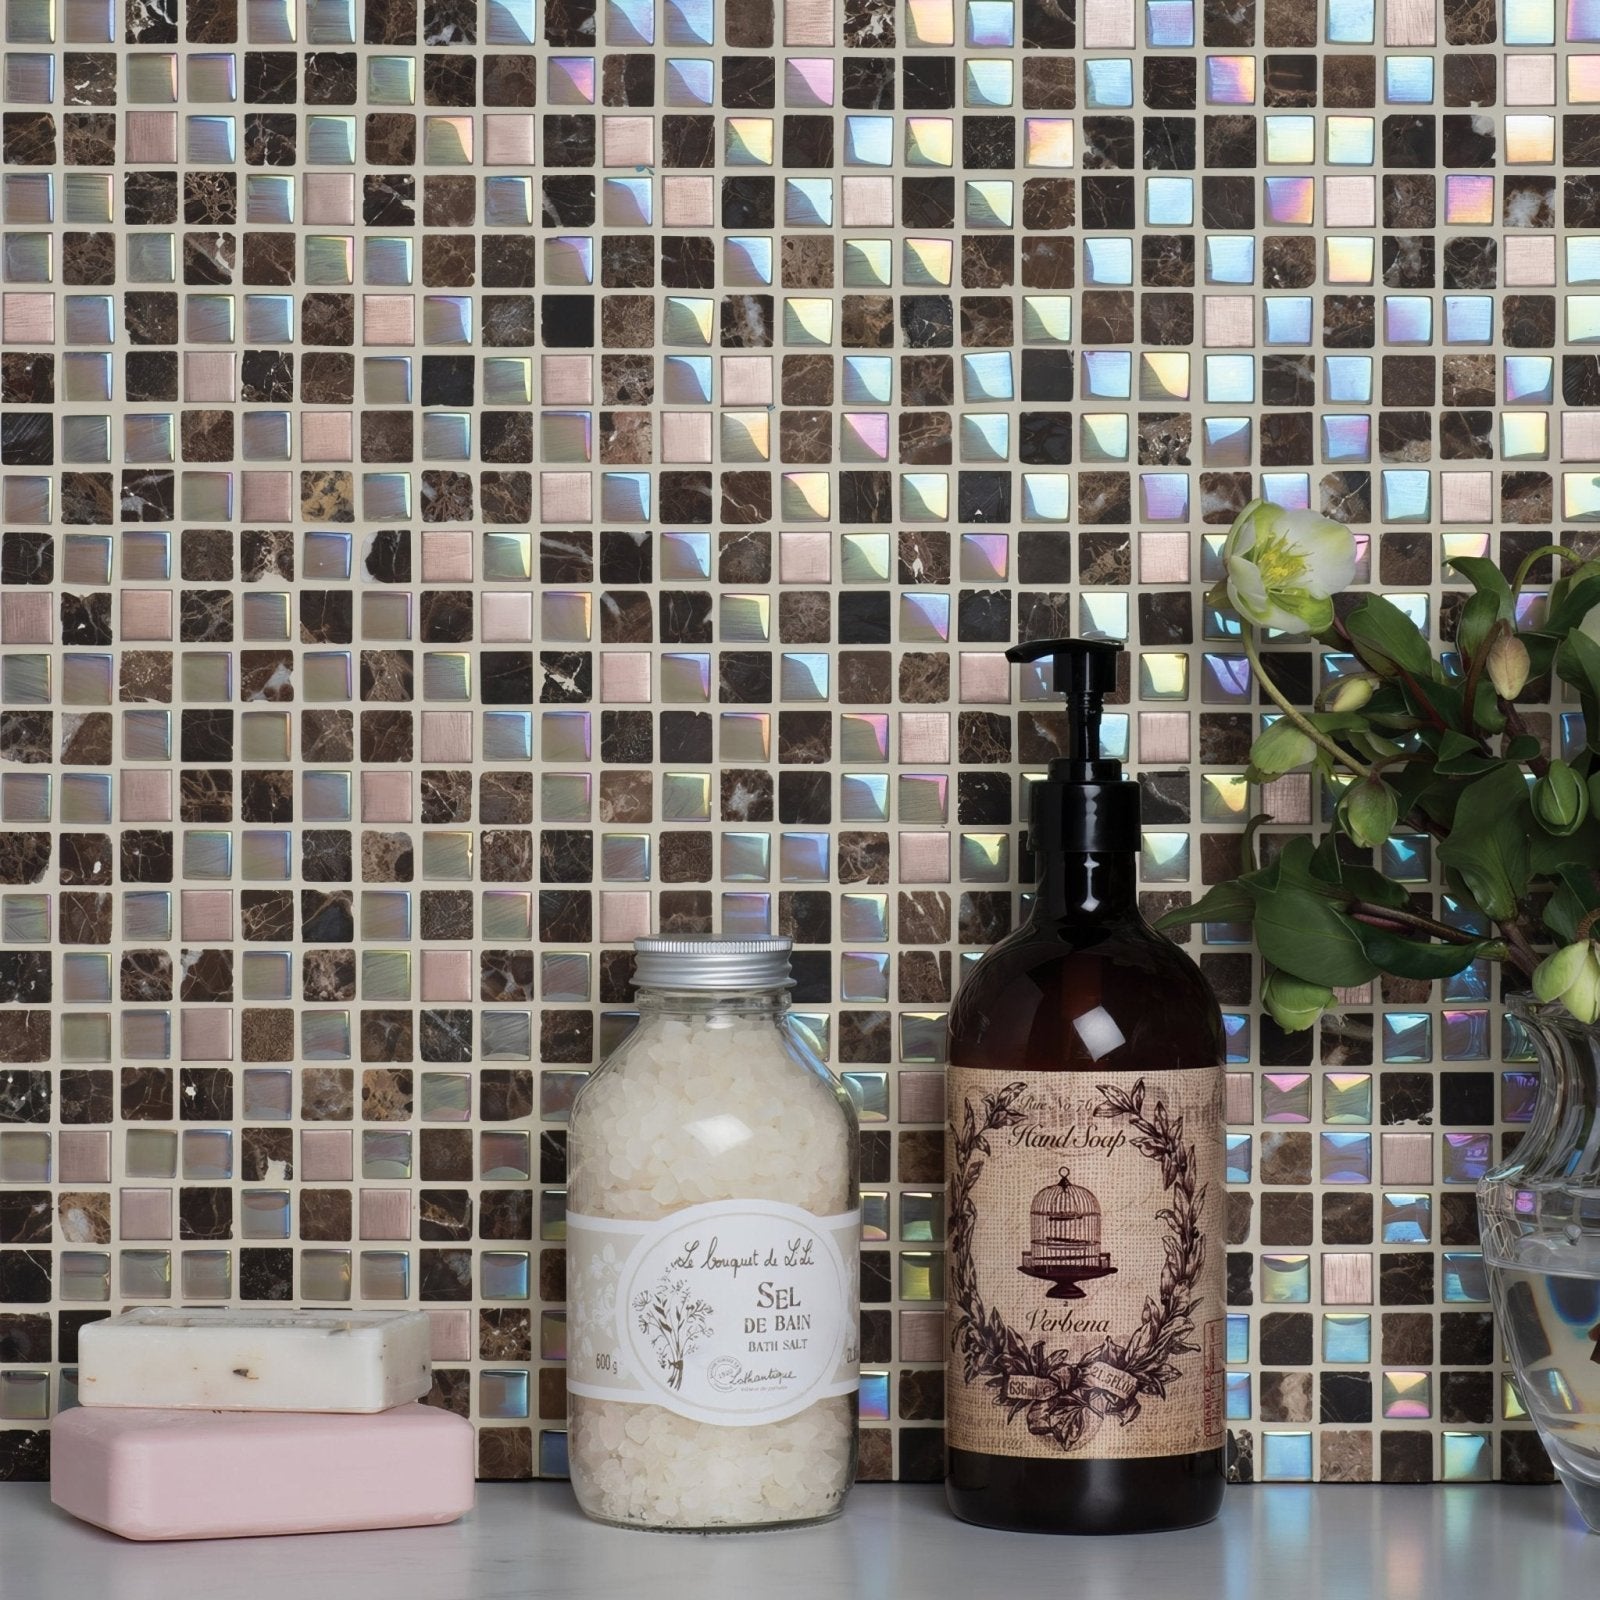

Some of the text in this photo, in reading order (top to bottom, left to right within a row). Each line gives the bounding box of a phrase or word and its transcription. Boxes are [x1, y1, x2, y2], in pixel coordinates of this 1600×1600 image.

[1008, 1123, 1126, 1157] Hand Soap
[677, 1239, 700, 1269] Le
[700, 1236, 759, 1278] bouquet
[763, 1247, 779, 1267] de
[744, 1313, 811, 1334] DE BAIN
[1024, 1308, 1111, 1333] Verbena
[748, 1338, 809, 1353] BATH SALT
[595, 1353, 611, 1371] 600
